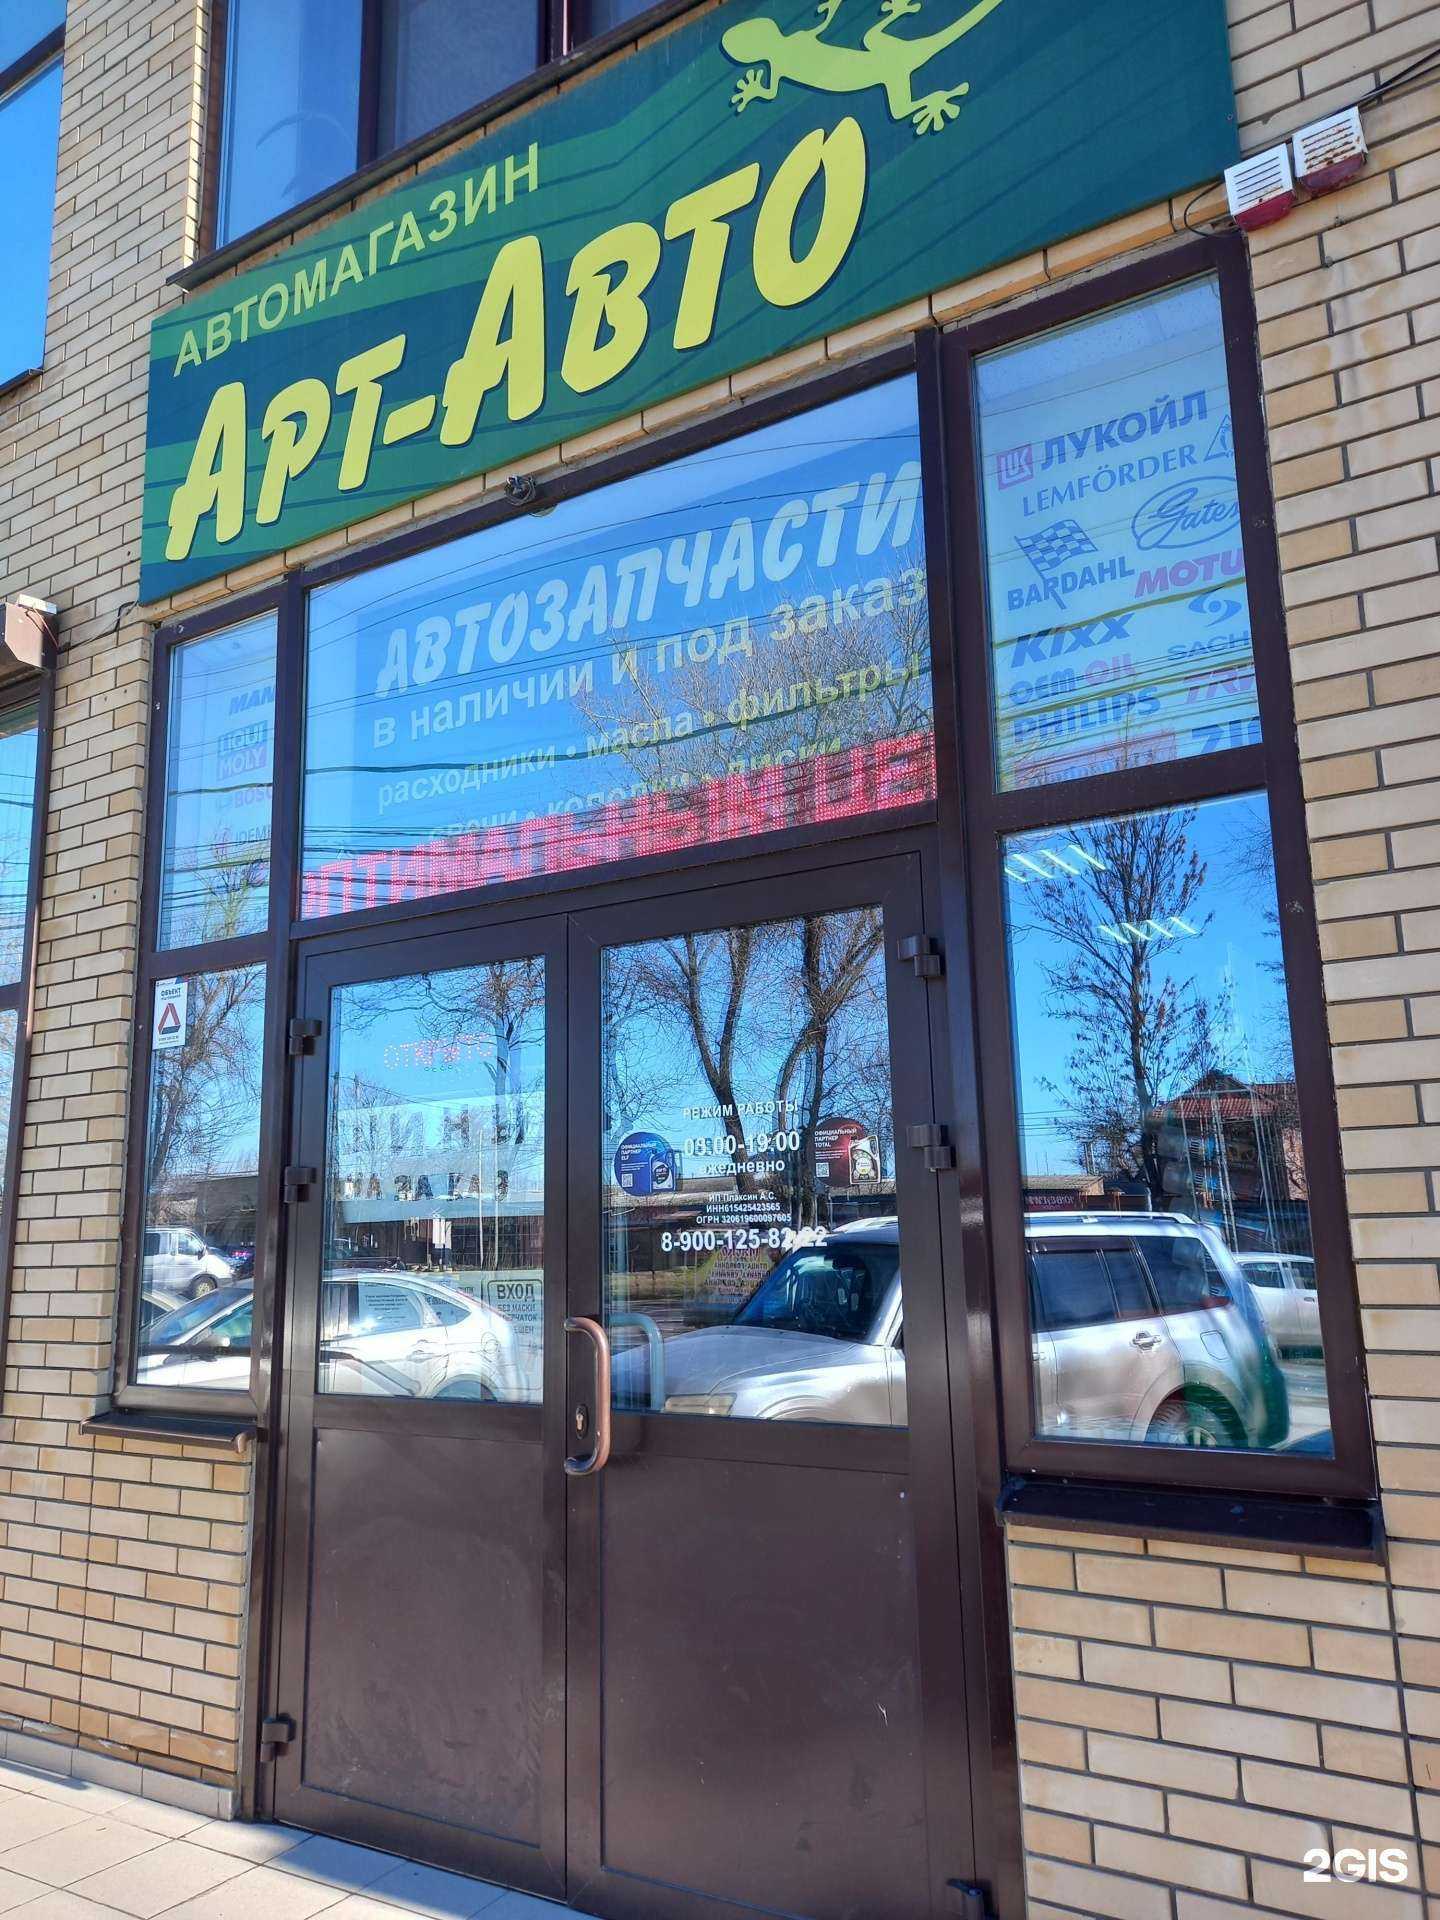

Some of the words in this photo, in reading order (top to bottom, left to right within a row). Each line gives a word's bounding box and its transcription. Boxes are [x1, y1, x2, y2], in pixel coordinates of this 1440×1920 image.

[174, 142, 540, 377] АВТОМАГАЗИН
[1041, 390, 1208, 470] ЛУКОЙЛ
[1022, 443, 1199, 516] LEMFÖRDER
[375, 461, 922, 698] АВТОЗАПЧАСТИ
[1007, 556, 1136, 612] BARDAHL
[373, 718, 396, 750] в
[410, 660, 594, 741] наличии
[655, 616, 752, 675] под
[378, 745, 557, 815] расходники
[586, 711, 694, 759] масла
[727, 654, 921, 732] фильтры
[1013, 686, 1161, 743] PHILIPS
[219, 746, 265, 778] MOLY
[683, 1104, 733, 1119] РЕЖИМ
[736, 1099, 799, 1117] РАБОТЫ
[697, 1160, 786, 1176] жедневно
[696, 1215, 719, 1225] ОГРН
[496, 1283, 536, 1302] ВХОД
